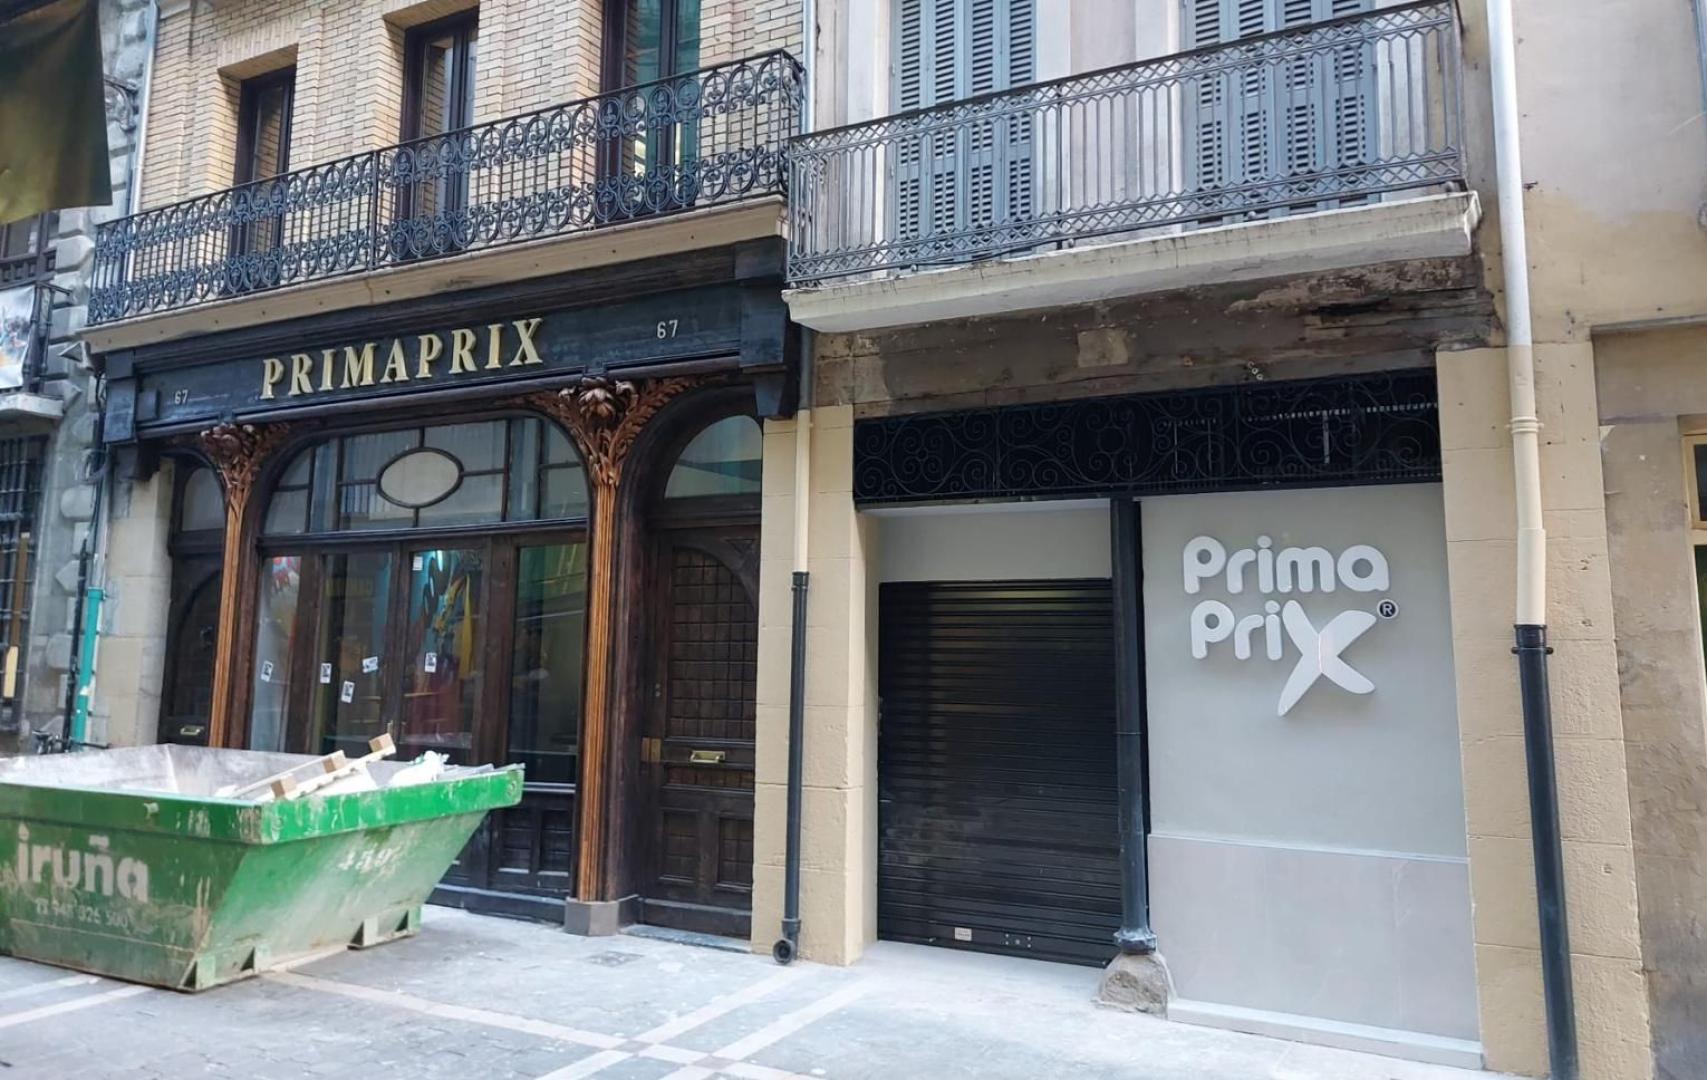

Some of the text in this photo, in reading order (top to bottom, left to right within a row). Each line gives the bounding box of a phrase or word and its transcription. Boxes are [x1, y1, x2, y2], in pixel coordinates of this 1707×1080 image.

[259, 317, 544, 400] PRIMAPRIX
[657, 319, 678, 339] 67
[174, 389, 188, 405] 67
[1183, 535, 1390, 595] Prima
[17, 821, 149, 903] iruña
